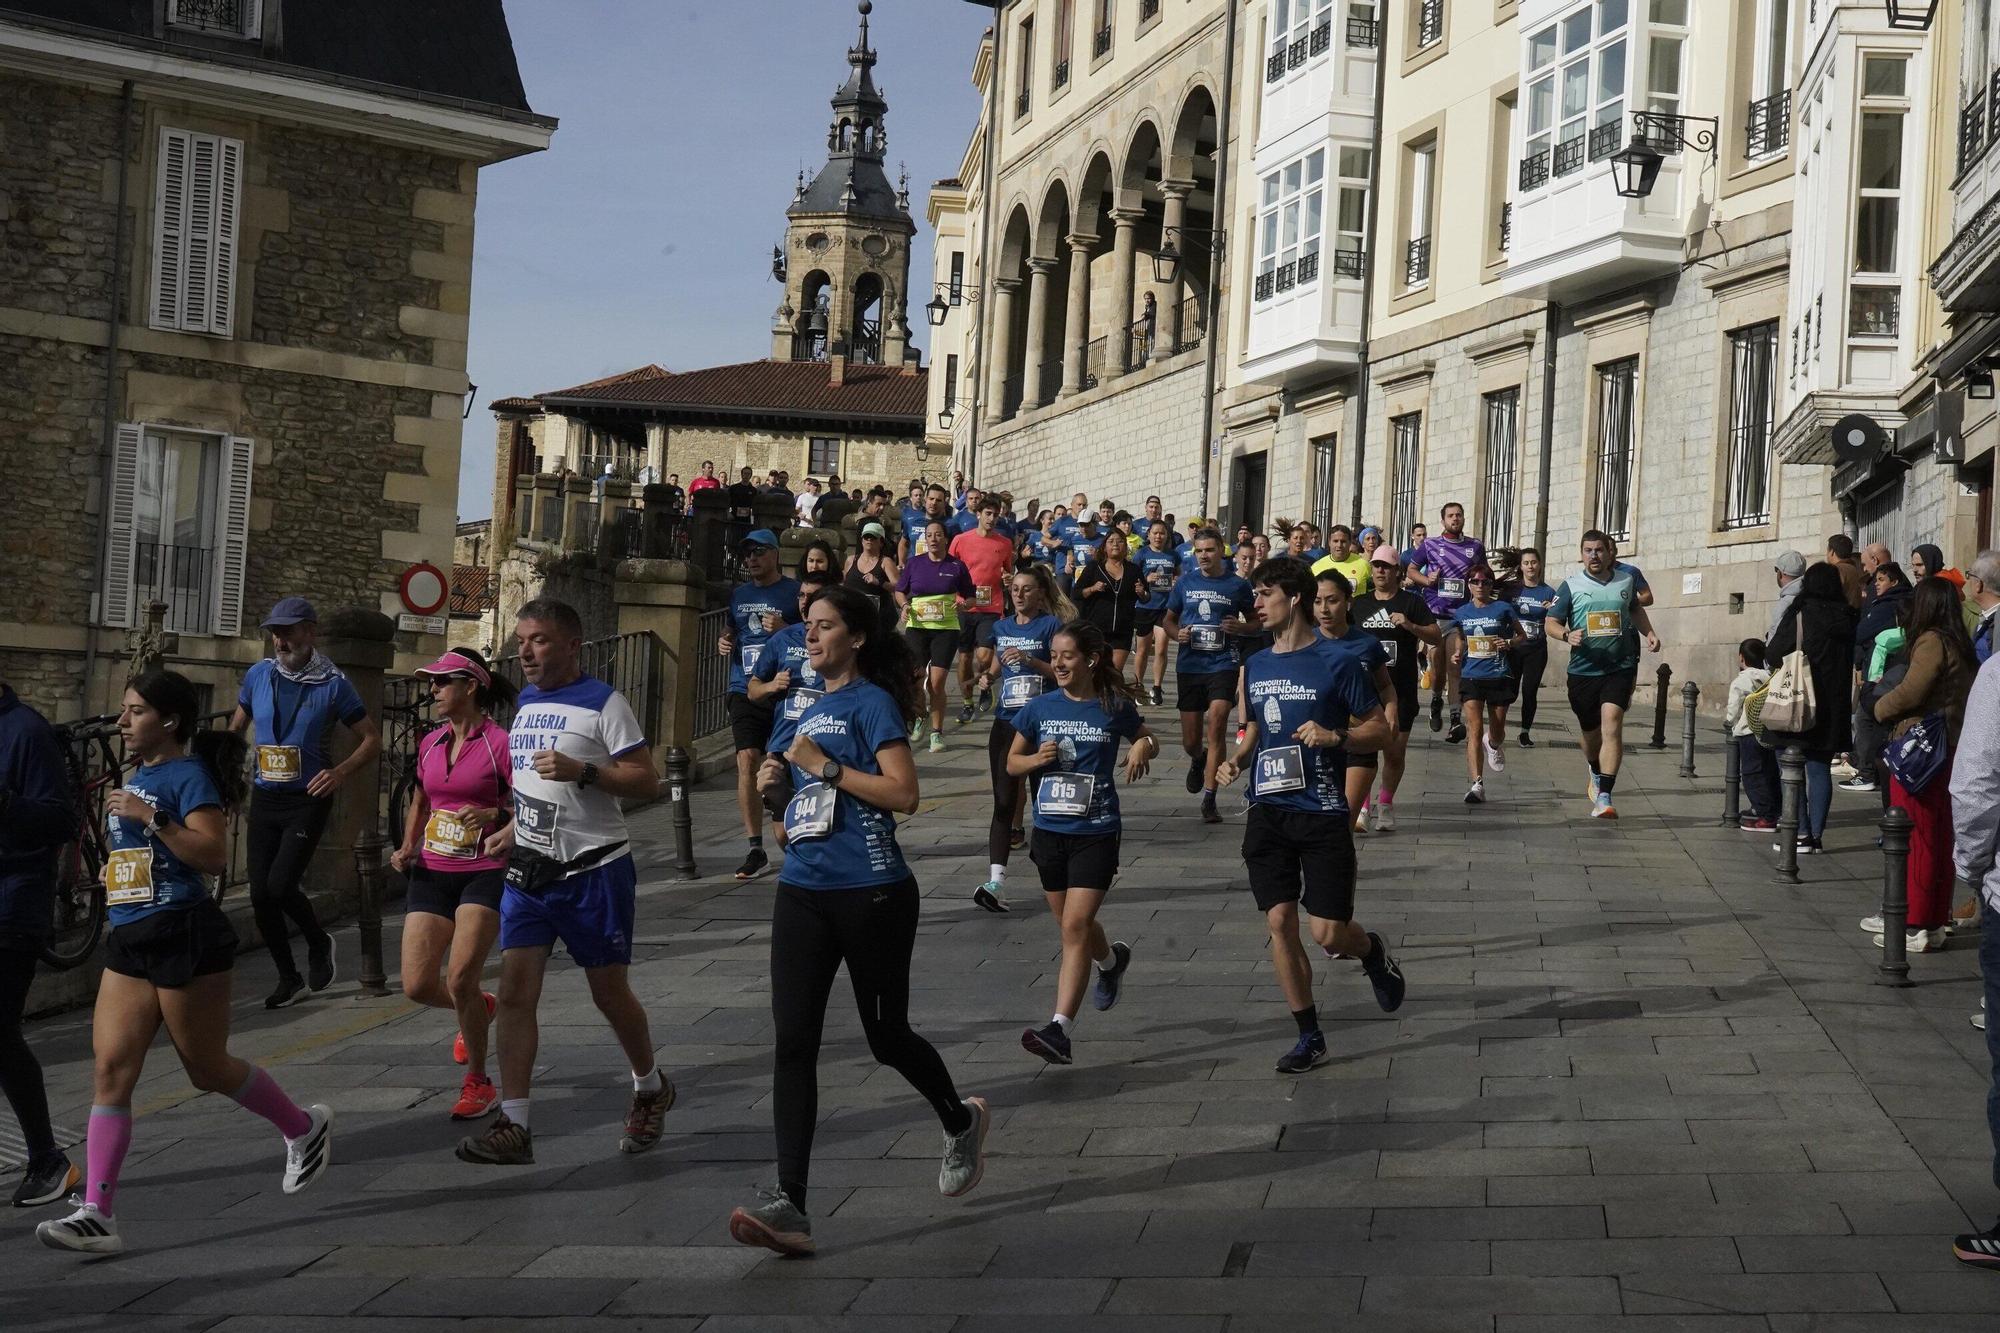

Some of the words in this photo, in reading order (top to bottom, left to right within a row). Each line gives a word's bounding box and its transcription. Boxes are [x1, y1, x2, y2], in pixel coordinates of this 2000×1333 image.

[1966, 484, 1973, 495] 2
[1362, 620, 1396, 629] adidas
[1600, 616, 1611, 627] 49
[1477, 641, 1490, 650] 149
[1255, 680, 1291, 688] CONQUISTA
[1255, 685, 1305, 696] ALMENDRA
[1279, 693, 1317, 701] KONKISTA
[523, 714, 567, 730] ALEGRIA
[1046, 719, 1088, 728] CONQUISTA
[1046, 726, 1103, 735] ALMENDRA
[510, 734, 536, 750] LEVIN
[539, 734, 547, 750] F.
[550, 735, 559, 750] 7
[267, 755, 287, 768] 123
[1263, 758, 1286, 777] 914
[1051, 782, 1076, 799] 815
[794, 796, 817, 821] 944
[518, 803, 539, 827] 745
[436, 820, 466, 842] 595
[114, 861, 136, 883] 557
